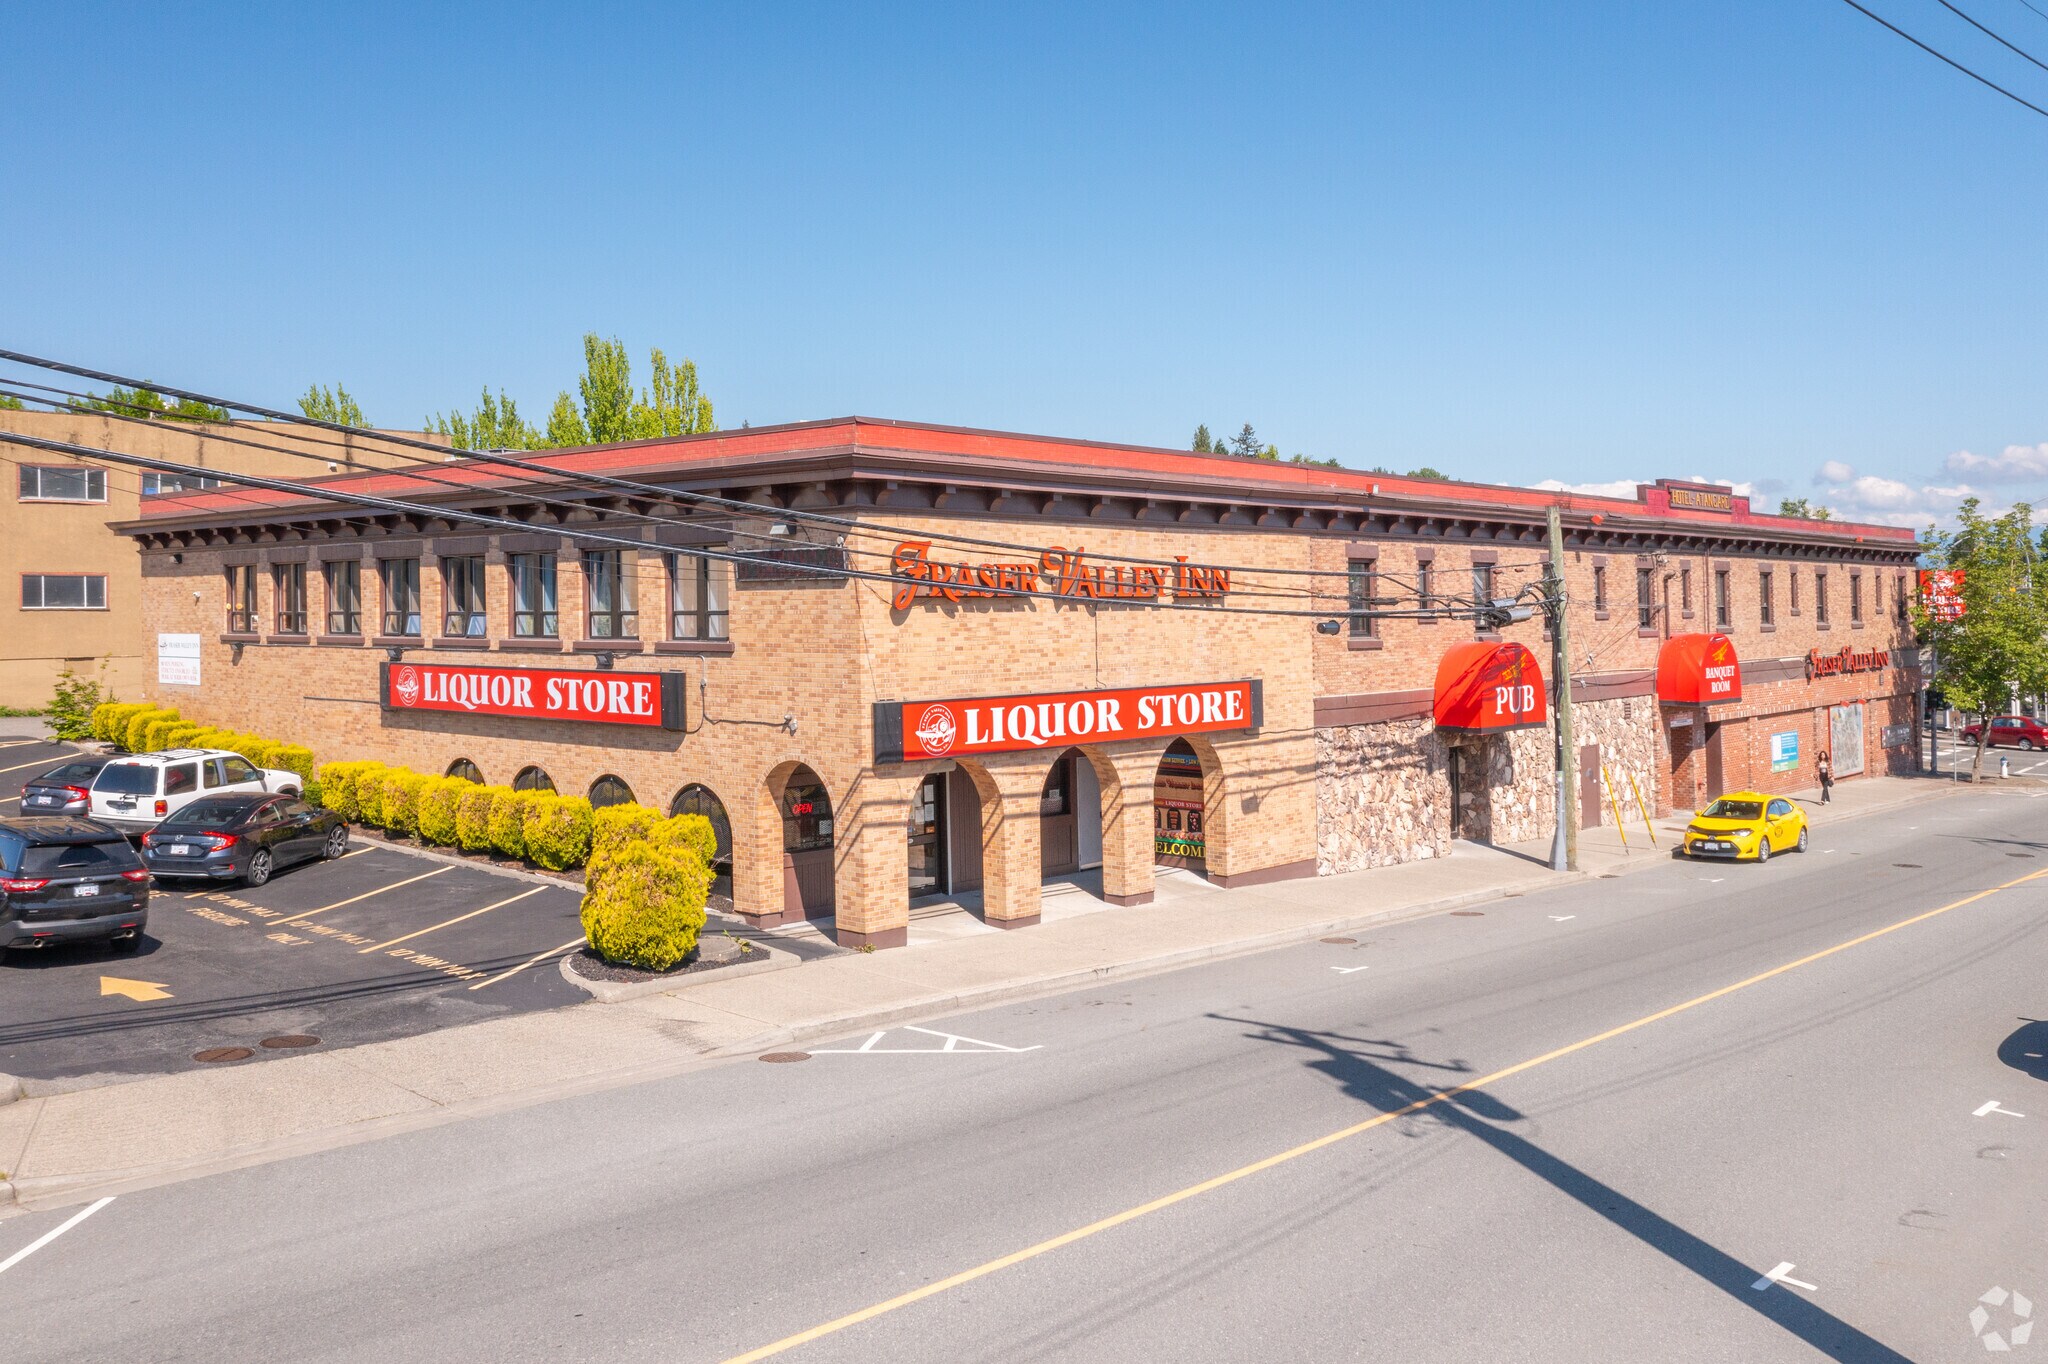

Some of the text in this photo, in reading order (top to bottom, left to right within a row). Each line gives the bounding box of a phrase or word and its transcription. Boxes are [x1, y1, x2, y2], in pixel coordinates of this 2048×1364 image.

[1672, 489, 1730, 509] HOTEL ATANGARD
[894, 541, 1231, 611] FRASER VALLEY INN
[1705, 665, 1735, 680] BANQUET
[1810, 645, 1889, 680] FRASER VALLEY INN
[423, 672, 535, 710] LIQUOR
[546, 677, 654, 716] STORE
[1711, 680, 1731, 693] ROOM
[1495, 685, 1535, 715] PUB
[964, 699, 1123, 746] LIQUOR
[1137, 690, 1244, 730] STORE
[792, 803, 813, 815] OPEN
[1155, 841, 1206, 858] ELCOM
[264, 932, 314, 946] ONLY
[284, 920, 376, 946] 10 MIN MAX
[385, 948, 487, 981] 10 MIN MAX
